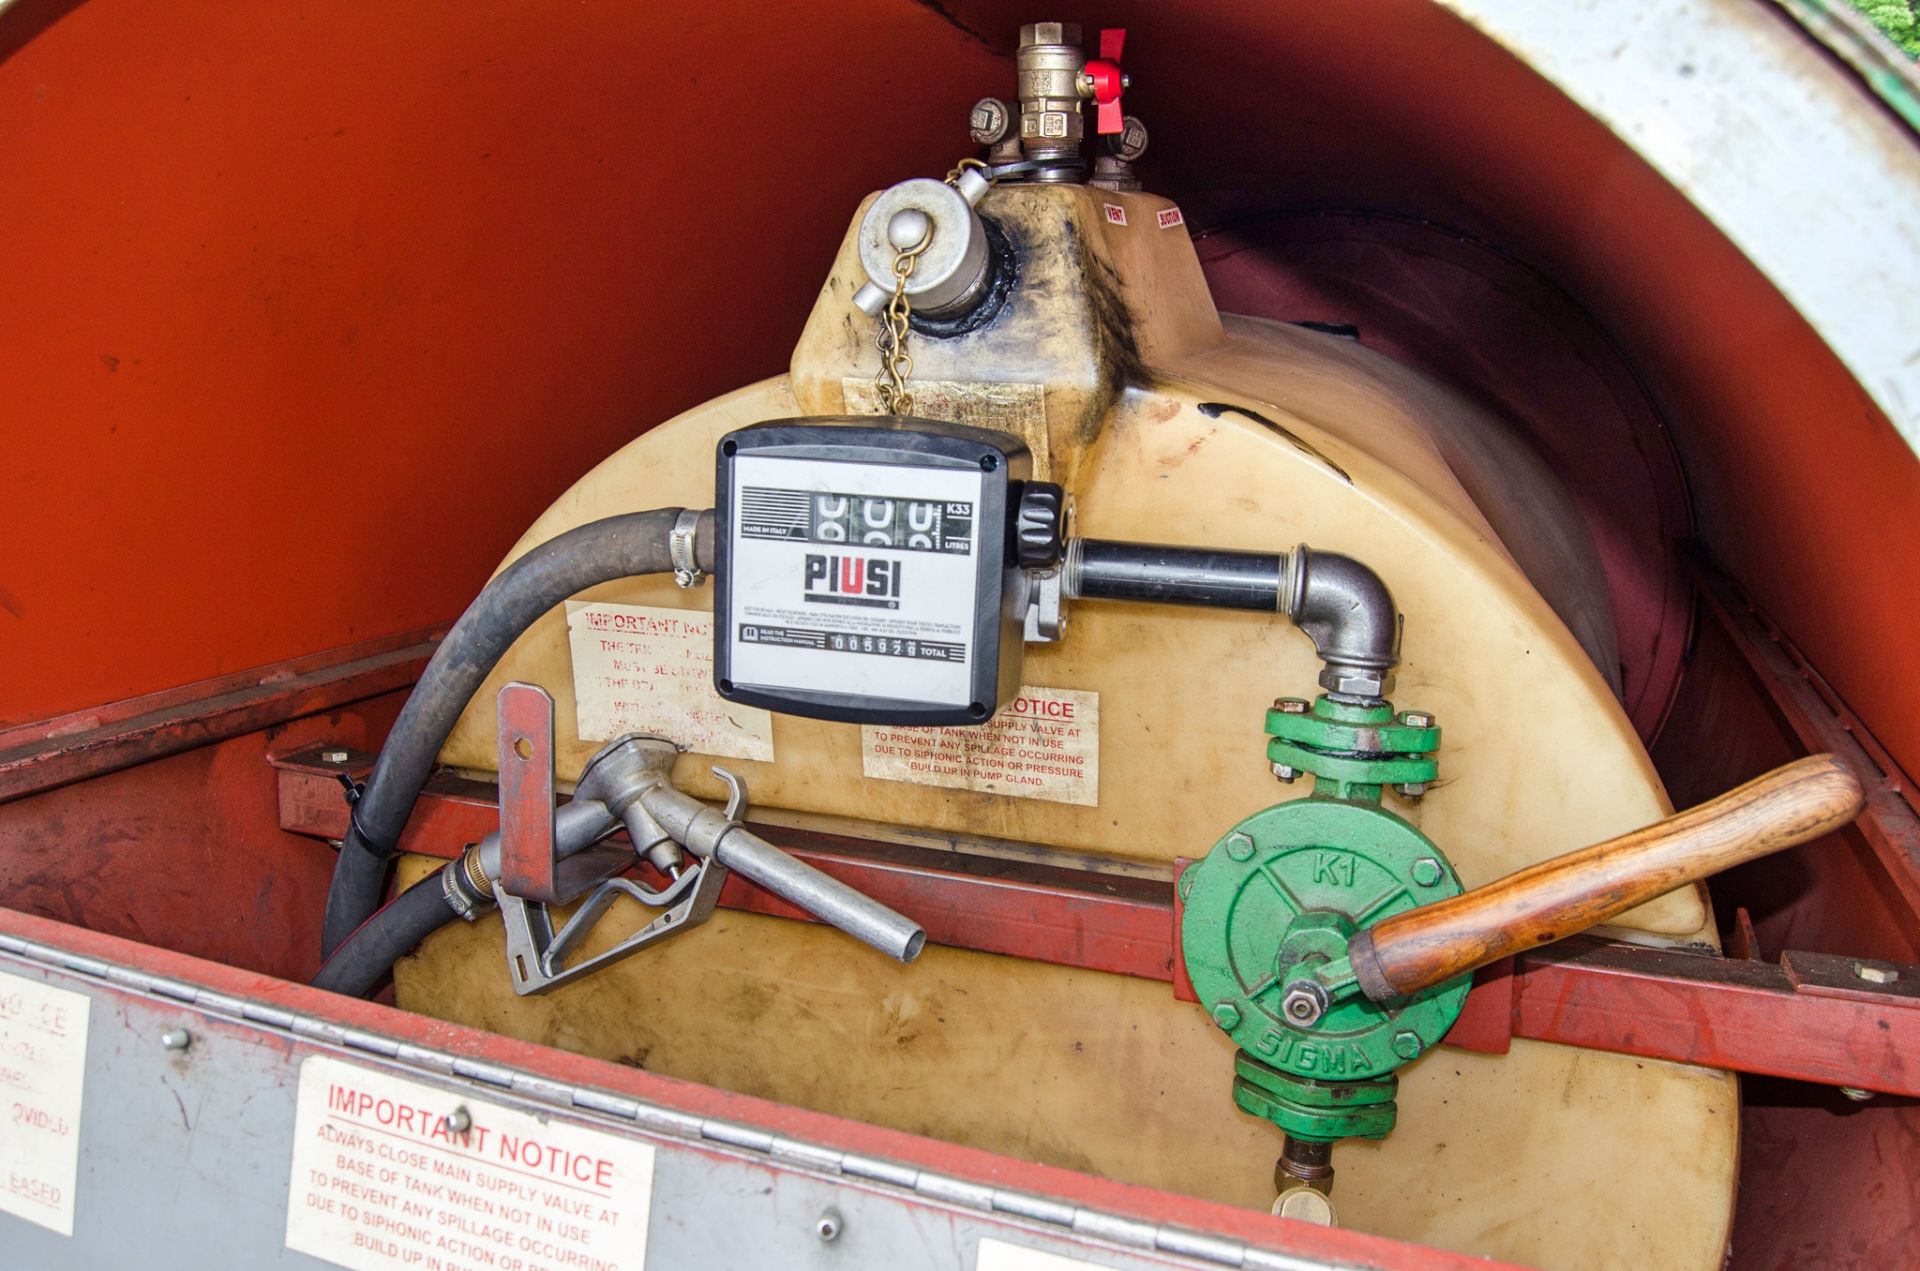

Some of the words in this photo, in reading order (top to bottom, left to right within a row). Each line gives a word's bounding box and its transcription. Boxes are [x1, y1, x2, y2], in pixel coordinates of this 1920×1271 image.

[1106, 206, 1123, 222] VENT
[1160, 210, 1180, 226] SUCTION
[947, 503, 970, 516] K33
[743, 525, 761, 533] MADE
[770, 527, 786, 535] ITALY
[945, 541, 969, 551] LITRES
[805, 553, 901, 598] PIUSI
[760, 635, 793, 643] INSTRUCTION
[794, 638, 815, 646] MANUAL
[920, 647, 947, 658] TOTAL
[1008, 698, 1074, 718] OTICE
[939, 727, 966, 737] TANK
[968, 731, 1000, 741] WHEN
[1003, 735, 1025, 744] NOT
[1029, 737, 1040, 746] IN
[1043, 739, 1064, 749] USE
[987, 720, 1027, 731] SUPPLY
[1030, 724, 1064, 736] VALVE
[1068, 729, 1081, 737] AT
[875, 732, 888, 741] TO
[890, 733, 937, 747] PREVENT
[940, 740, 961, 750] ANY
[964, 744, 1016, 757] SPILLAGE
[1019, 749, 1084, 765] OCCURRING
[875, 744, 895, 755] DUE
[898, 747, 912, 757] TO
[914, 749, 962, 764] SIPHONIC
[966, 755, 1005, 769] ACTION
[1007, 761, 1023, 771] OR
[1026, 763, 1084, 778] PRESSURE
[910, 761, 941, 773] BUILD
[944, 765, 957, 775] UP
[960, 768, 970, 777] IN
[973, 769, 1003, 780] PUMP
[1313, 853, 1357, 887] K1
[1256, 1028, 1373, 1073] SIGMA
[500, 1133, 613, 1188] NOTICE
[316, 1125, 374, 1153] ALWAYS
[378, 1143, 428, 1170] CLOSE
[432, 1160, 471, 1182] MAIN
[476, 1173, 537, 1202] SUPPLY
[543, 1192, 593, 1220] VALVE
[598, 1209, 620, 1227] AT
[309, 1169, 328, 1187] TO
[331, 1176, 398, 1209] PREVENT
[402, 1200, 433, 1220] ANY
[437, 1210, 515, 1246] SPILLAGE
[336, 1154, 375, 1179] BASE
[379, 1168, 399, 1184] OF
[404, 1175, 443, 1198] TANK
[447, 1189, 494, 1215] WHEN
[499, 1205, 532, 1226] NOT
[537, 1215, 553, 1233] IN
[558, 1223, 591, 1245] USE
[306, 1192, 335, 1214] DUE
[340, 1203, 359, 1221] TO
[362, 1210, 432, 1245] SIPHONIC
[436, 1235, 495, 1265] ACTION
[499, 1255, 524, 1271] OR
[354, 1231, 398, 1258] BUILD
[402, 1247, 423, 1264] UP
[426, 1256, 442, 1271] IN
